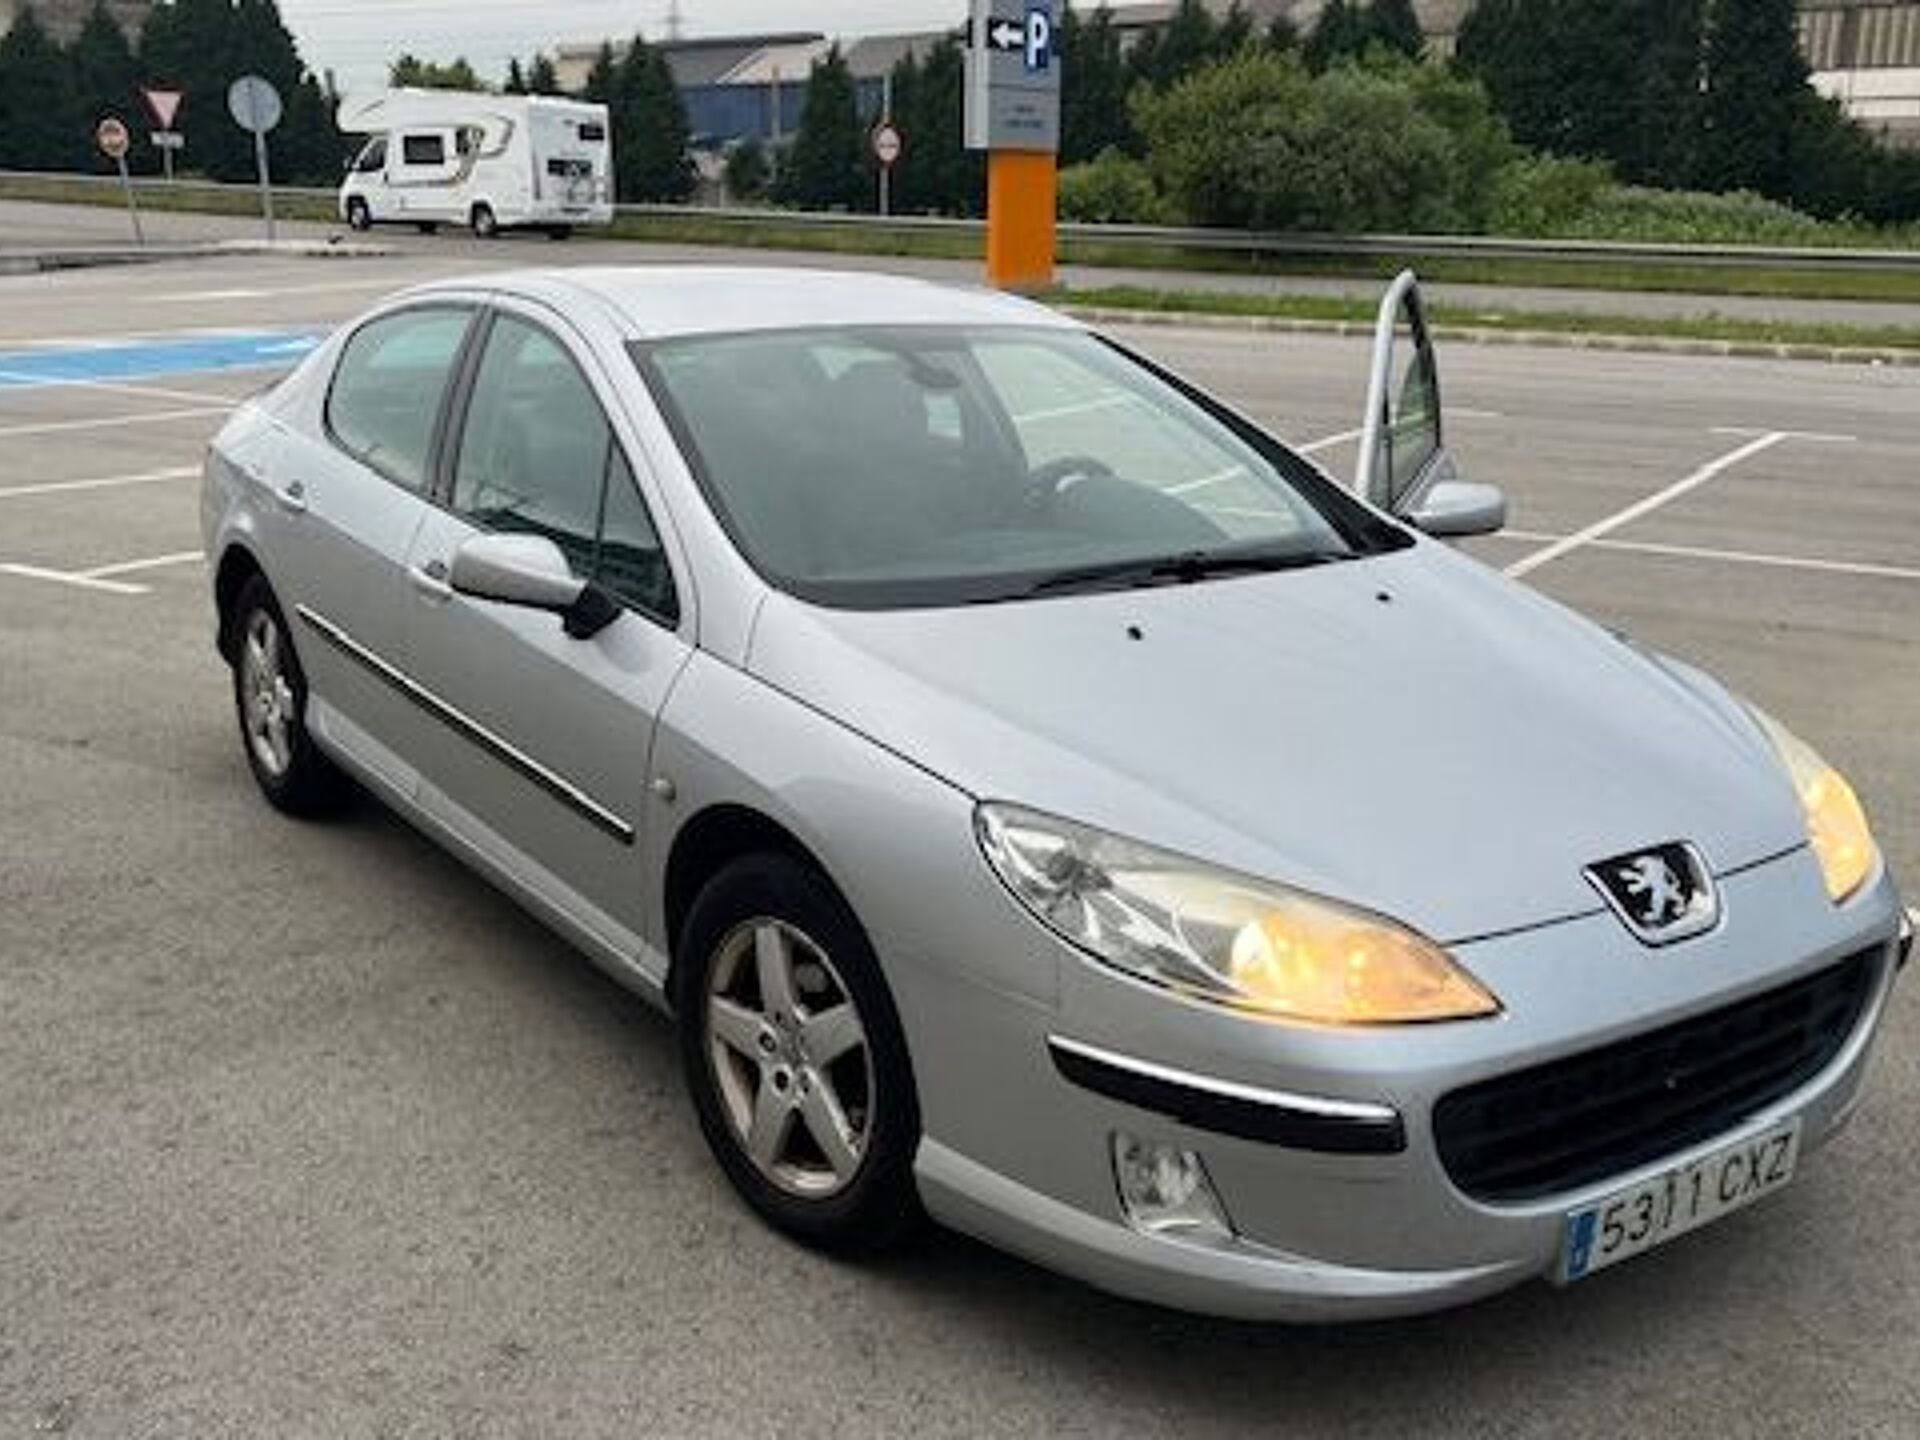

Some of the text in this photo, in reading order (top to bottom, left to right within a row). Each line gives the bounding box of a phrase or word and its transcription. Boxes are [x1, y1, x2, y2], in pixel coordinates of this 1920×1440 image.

[1027, 11, 1049, 66] P
[1602, 1132, 1794, 1254] 5311 CXZ
